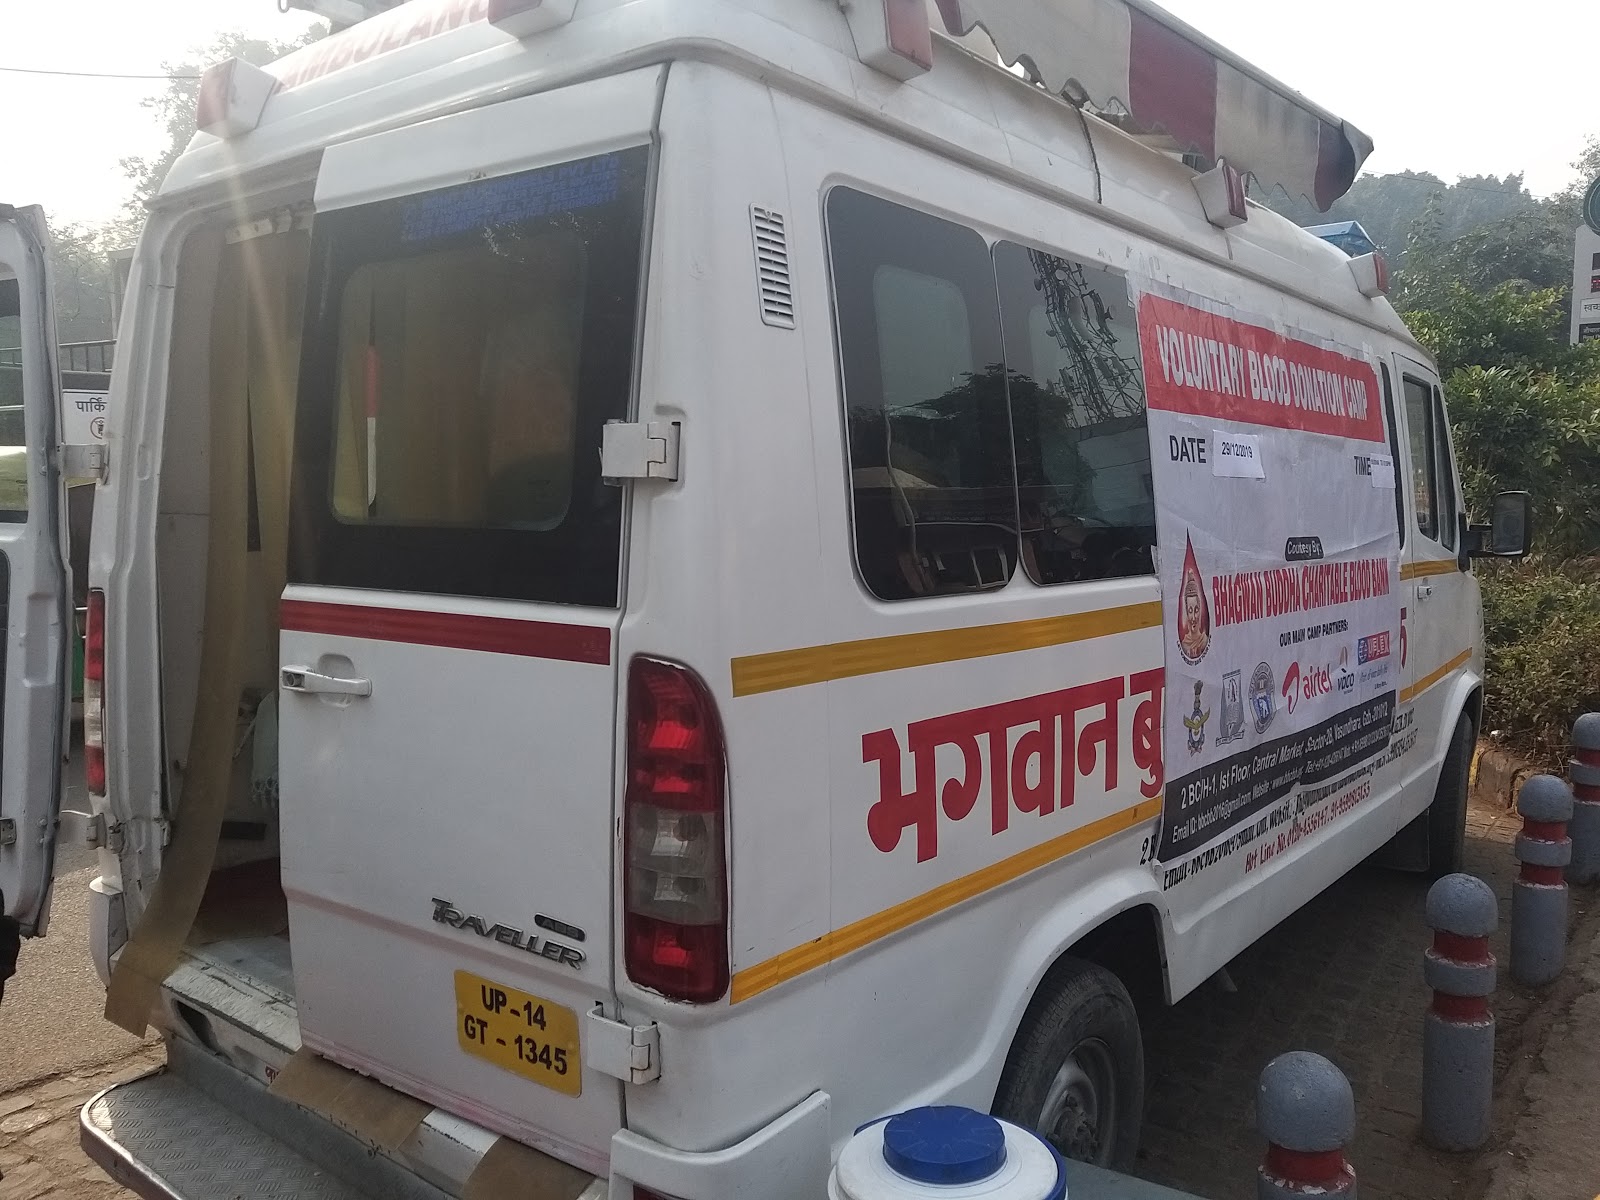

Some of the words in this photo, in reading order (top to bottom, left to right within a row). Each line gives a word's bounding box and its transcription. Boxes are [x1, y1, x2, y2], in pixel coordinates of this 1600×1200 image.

[1156, 324, 1246, 398] VOLUNTARY
[1247, 349, 1291, 406] BLOOD
[1289, 361, 1346, 417] DONATION
[1343, 375, 1368, 421] CAMP
[1169, 434, 1207, 464] DATE
[1221, 441, 1253, 459] 29/12/2019
[1353, 455, 1371, 476] TIME
[1212, 572, 1264, 628] BHAGWAN
[1263, 567, 1302, 617] BUDDHA
[1302, 561, 1349, 612] CHARITABLE
[1349, 558, 1371, 602] BLOOD
[1279, 631, 1292, 648] OUR
[1292, 628, 1306, 644] MAIN
[1307, 624, 1322, 641] CAMP
[1303, 663, 1333, 700] airtel
[862, 675, 1126, 864] भगवान
[1181, 787, 1187, 810] 2
[1230, 763, 1251, 787] Floor,
[1252, 747, 1280, 775] Central
[1172, 821, 1190, 844] Email
[1245, 848, 1258, 875] Hot
[431, 897, 587, 971] TRAVELLER
[514, 1034, 568, 1077] 1345
